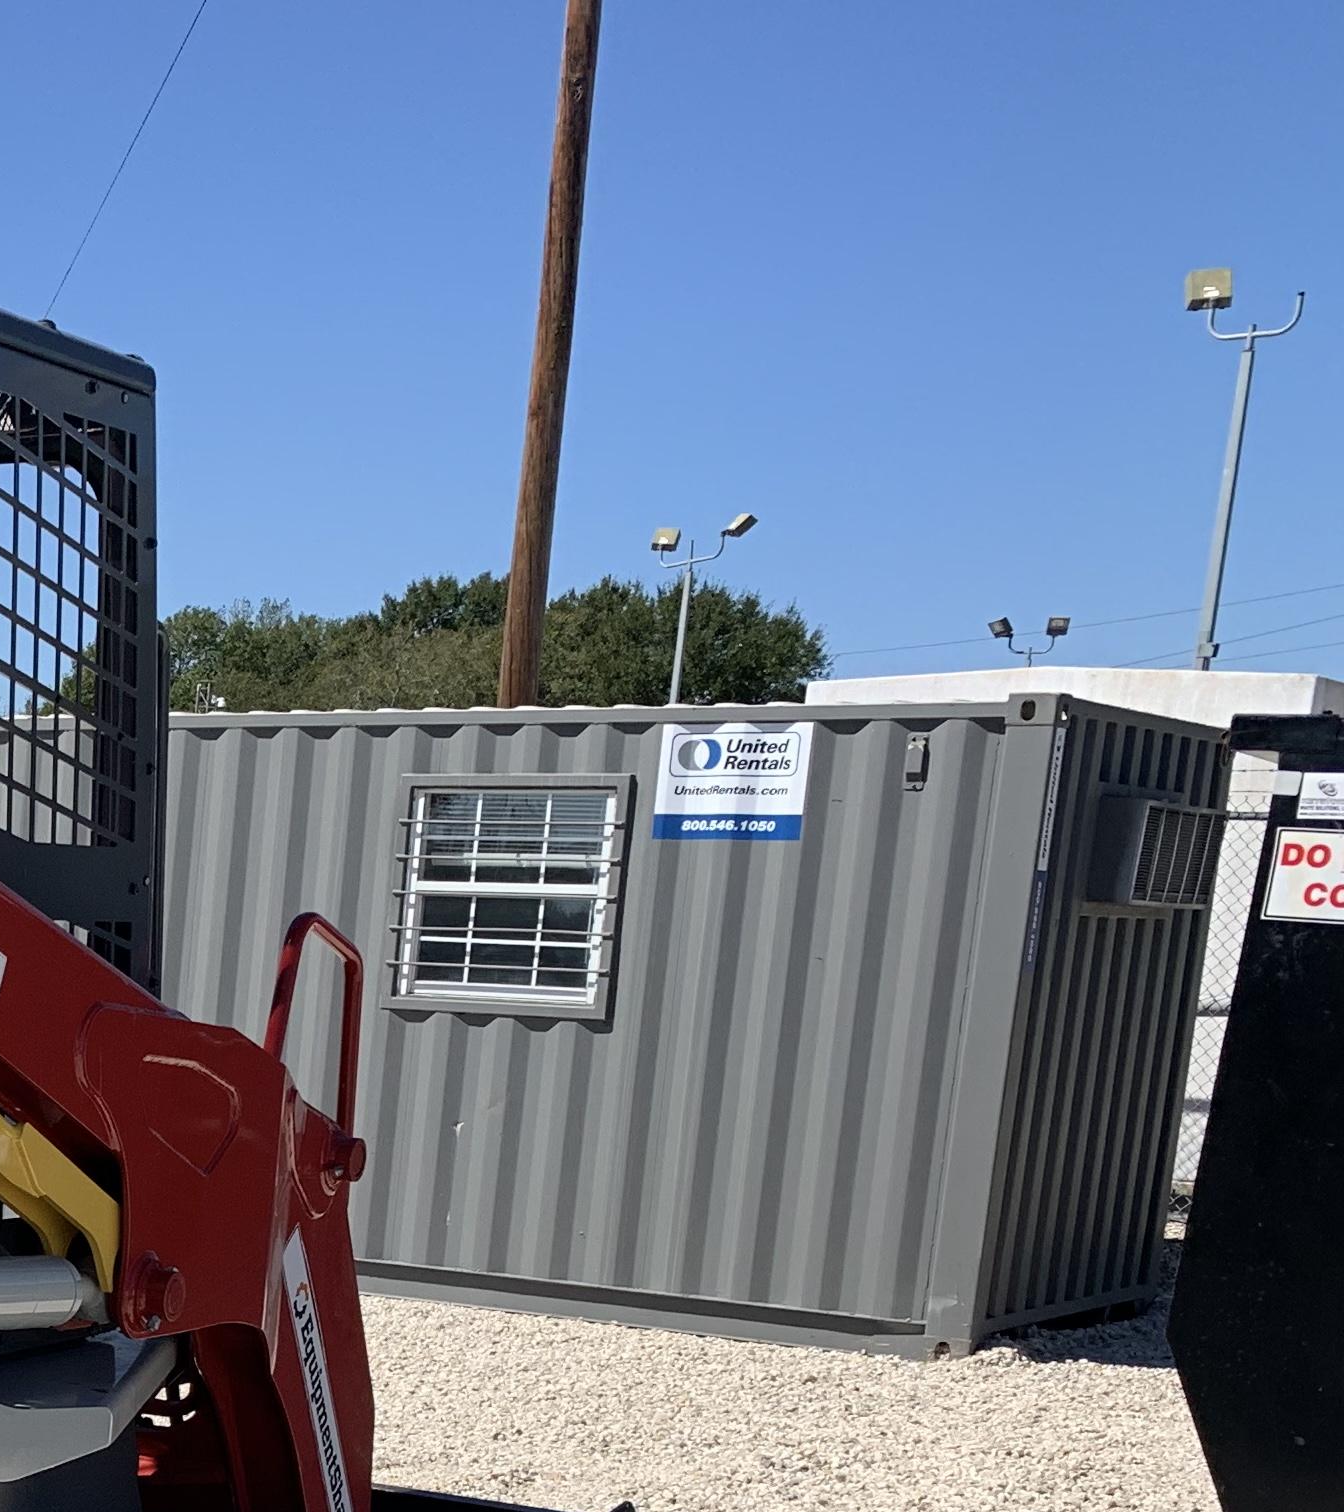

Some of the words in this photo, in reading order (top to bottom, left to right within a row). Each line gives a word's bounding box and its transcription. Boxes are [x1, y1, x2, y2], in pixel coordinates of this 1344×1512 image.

[726, 738, 790, 753] United
[724, 756, 791, 770] Rentals
[674, 784, 789, 796] UnitedRentals.com
[681, 819, 777, 832] 800.546.1050
[1280, 843, 1331, 868] DO
